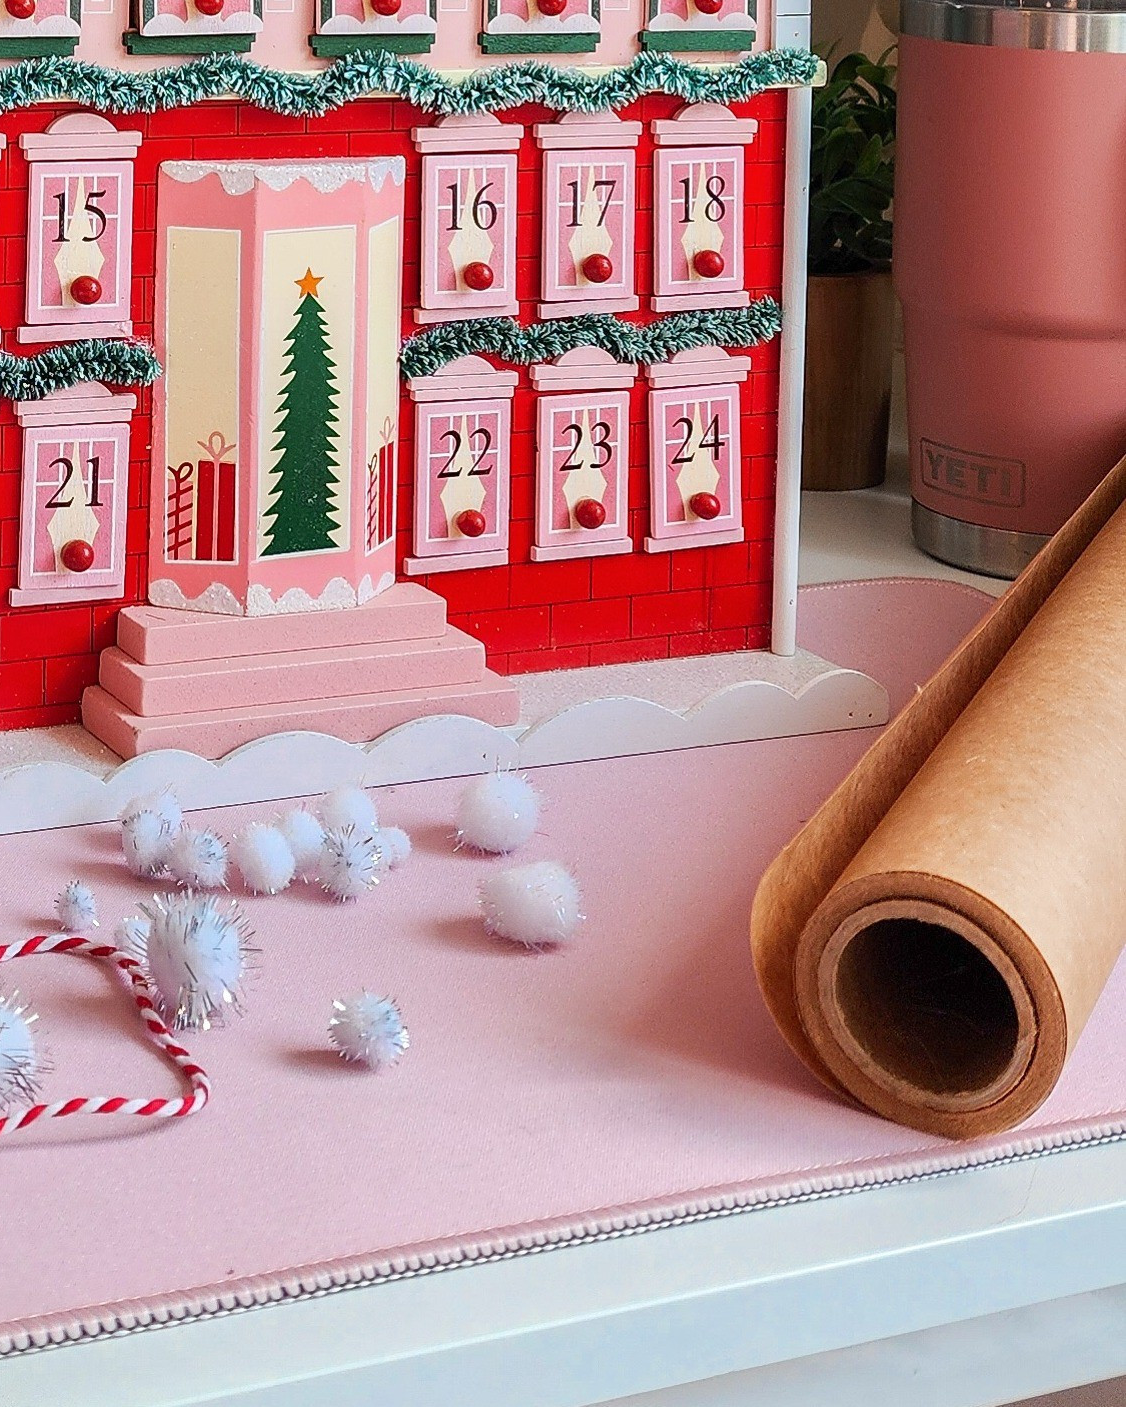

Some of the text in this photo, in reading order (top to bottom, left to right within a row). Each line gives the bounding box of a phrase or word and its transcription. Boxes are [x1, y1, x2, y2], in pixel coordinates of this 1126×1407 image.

[51, 190, 107, 242] 15
[445, 182, 498, 231] 16
[565, 180, 617, 227] 17
[678, 175, 727, 223] 18
[437, 427, 493, 479] 22
[559, 421, 613, 472] 23
[670, 414, 725, 464] 24
[44, 456, 104, 509] 21
[925, 448, 1011, 498] YETI
